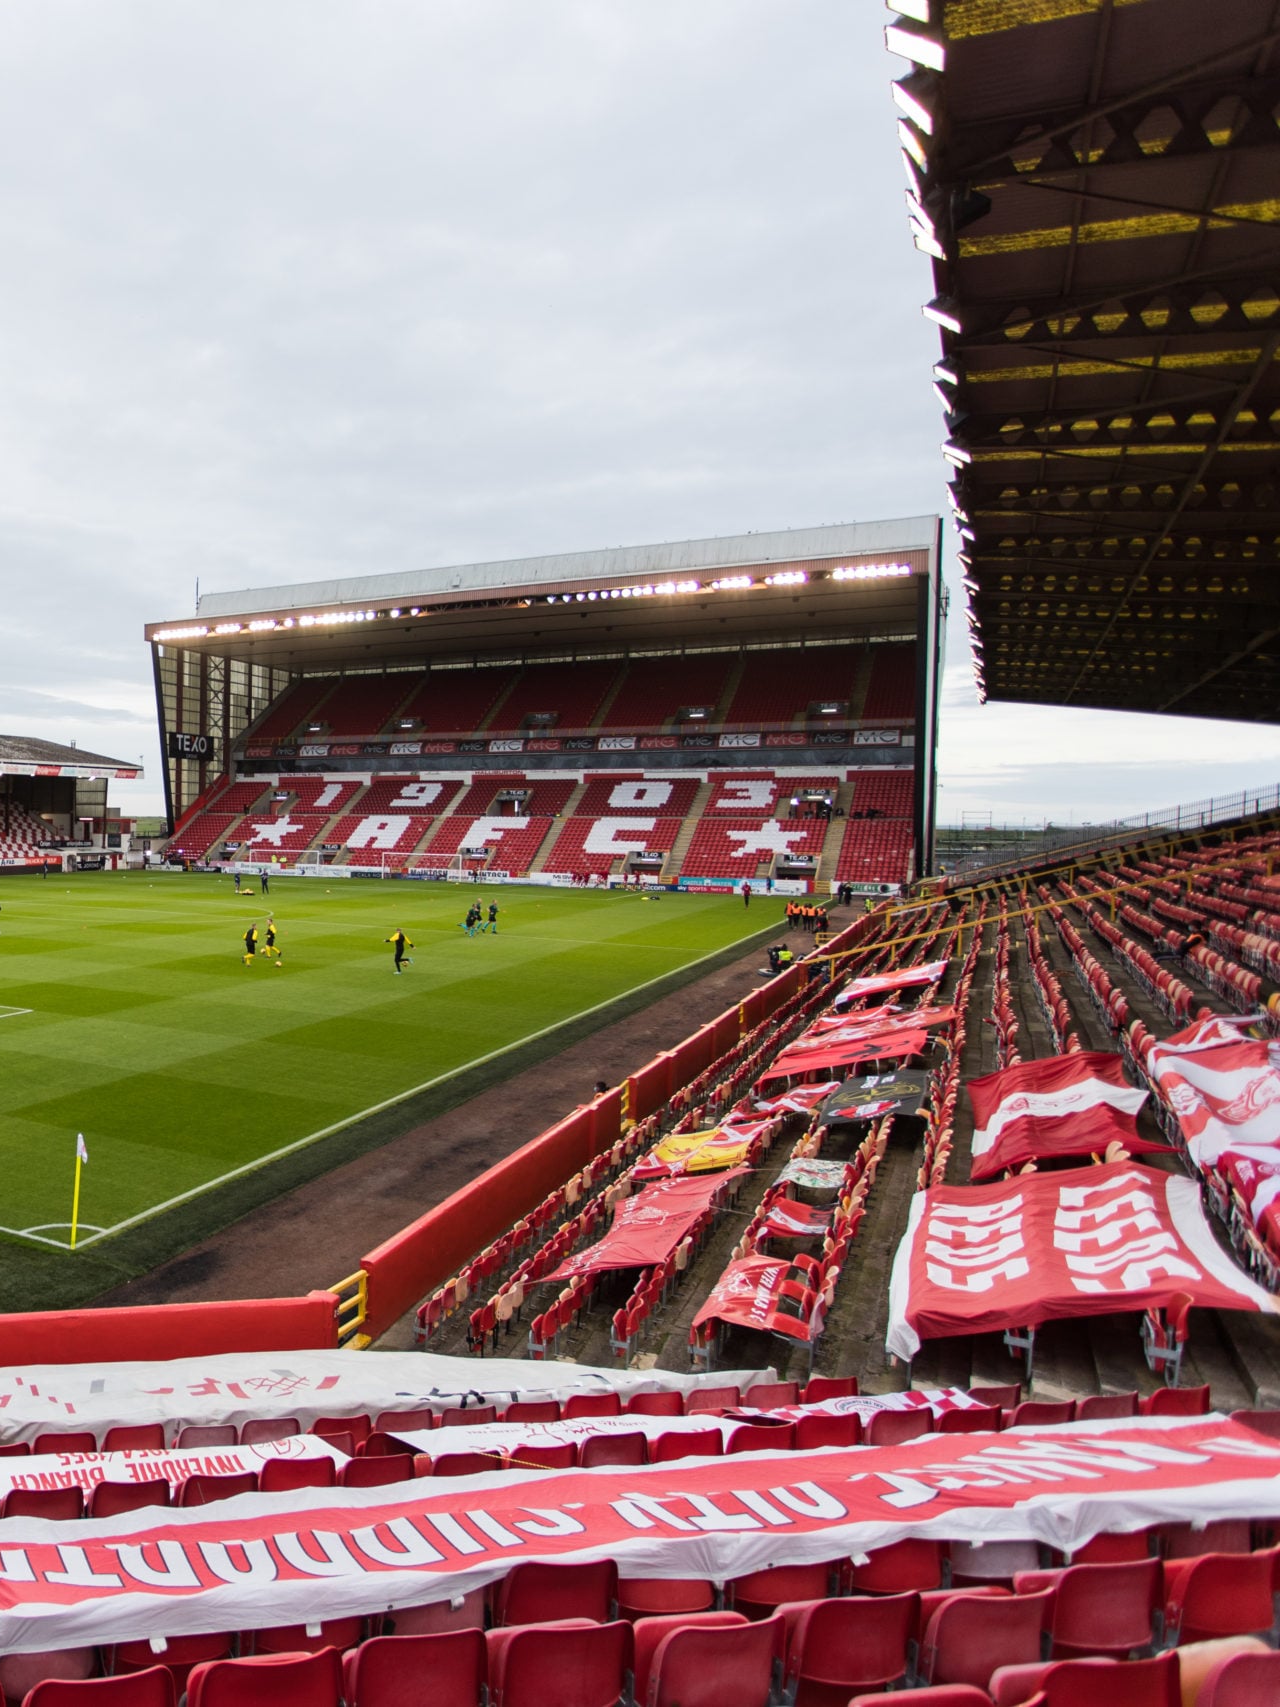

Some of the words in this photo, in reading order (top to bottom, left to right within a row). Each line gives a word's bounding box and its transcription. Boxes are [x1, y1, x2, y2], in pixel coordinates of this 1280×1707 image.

[926, 1195, 1030, 1293] REDS
[1053, 1169, 1202, 1293] LEEDS
[8, 1465, 105, 1492] BRANCH
[129, 1453, 245, 1483] INVERURIE
